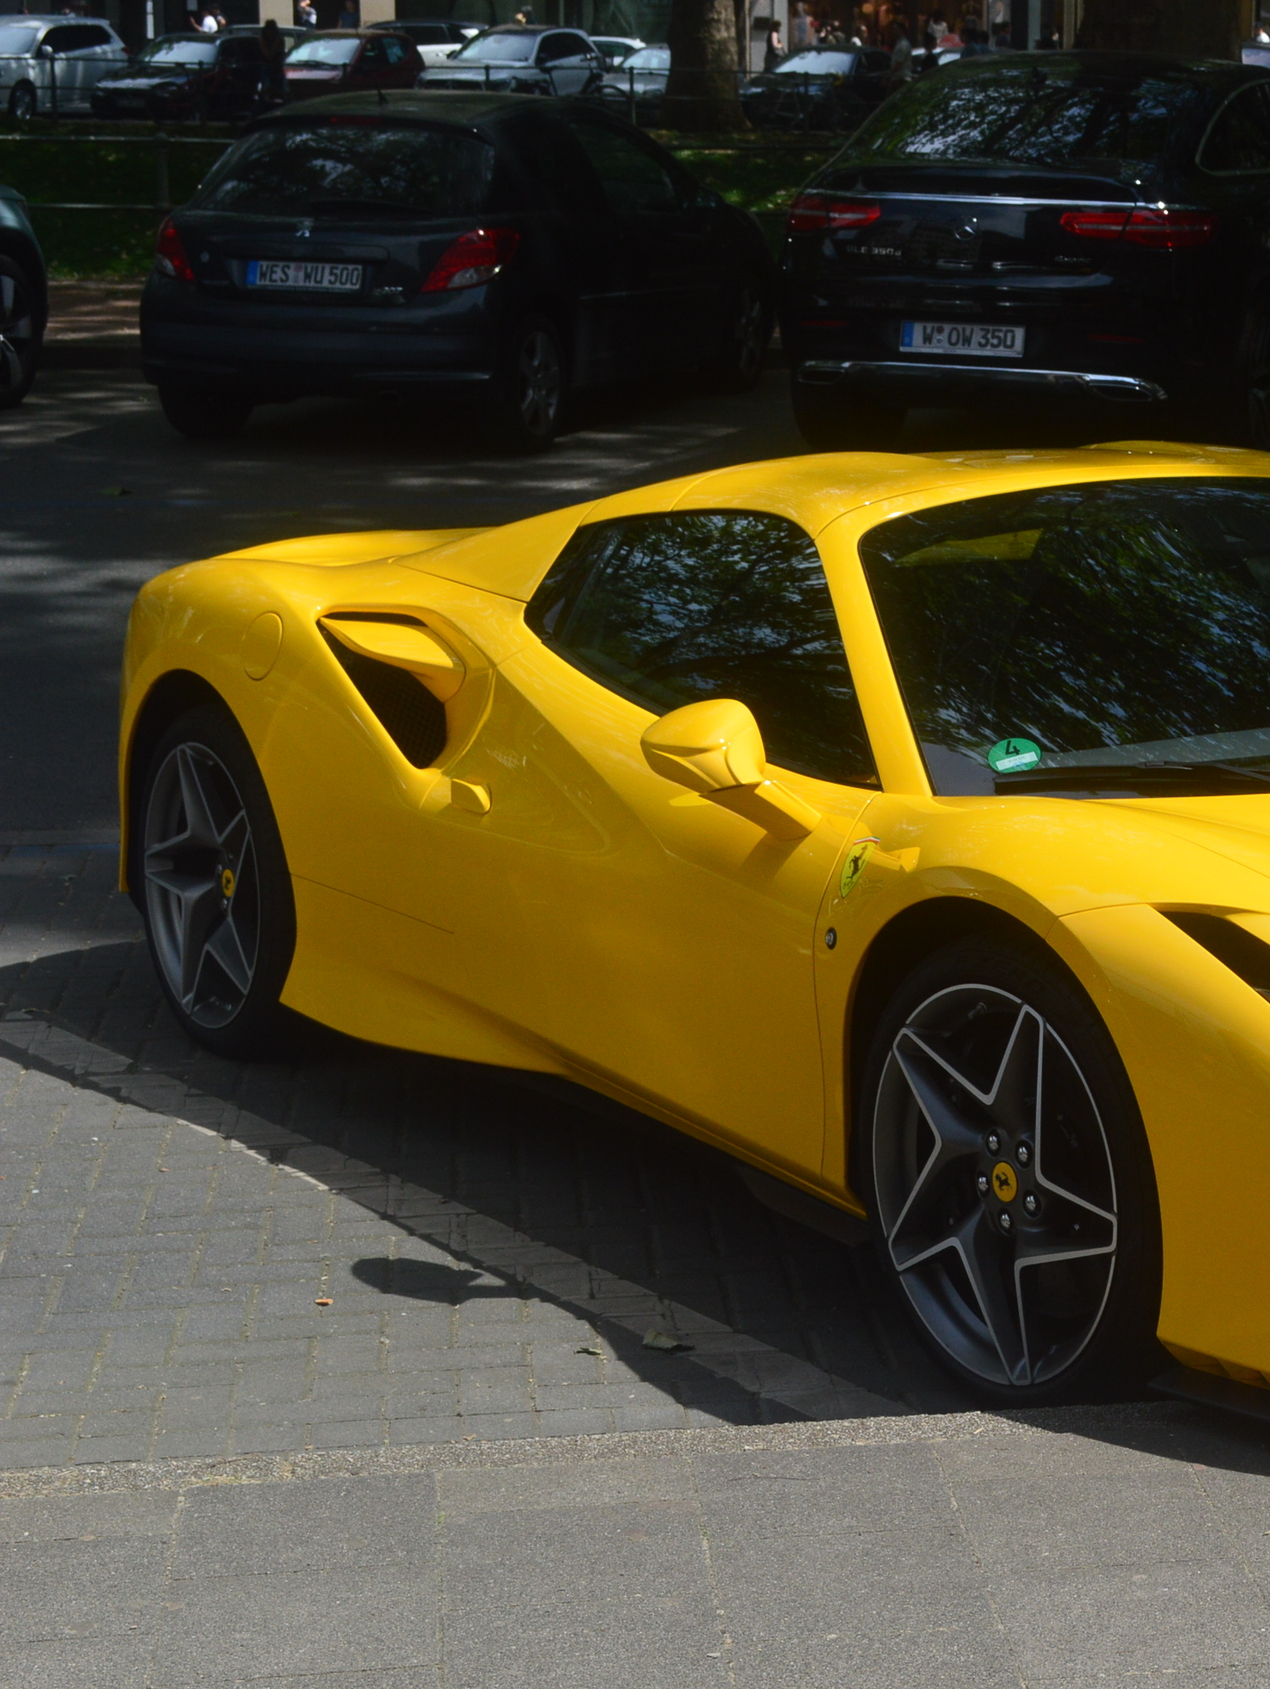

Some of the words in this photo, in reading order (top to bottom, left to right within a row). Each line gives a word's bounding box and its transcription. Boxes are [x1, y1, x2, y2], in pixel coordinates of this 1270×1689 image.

[259, 264, 290, 283] WES
[304, 265, 323, 284] WU
[328, 266, 360, 286] 500
[923, 325, 934, 345] W
[948, 326, 974, 347] OW
[978, 328, 1015, 349] 350
[1005, 739, 1021, 755] 4
